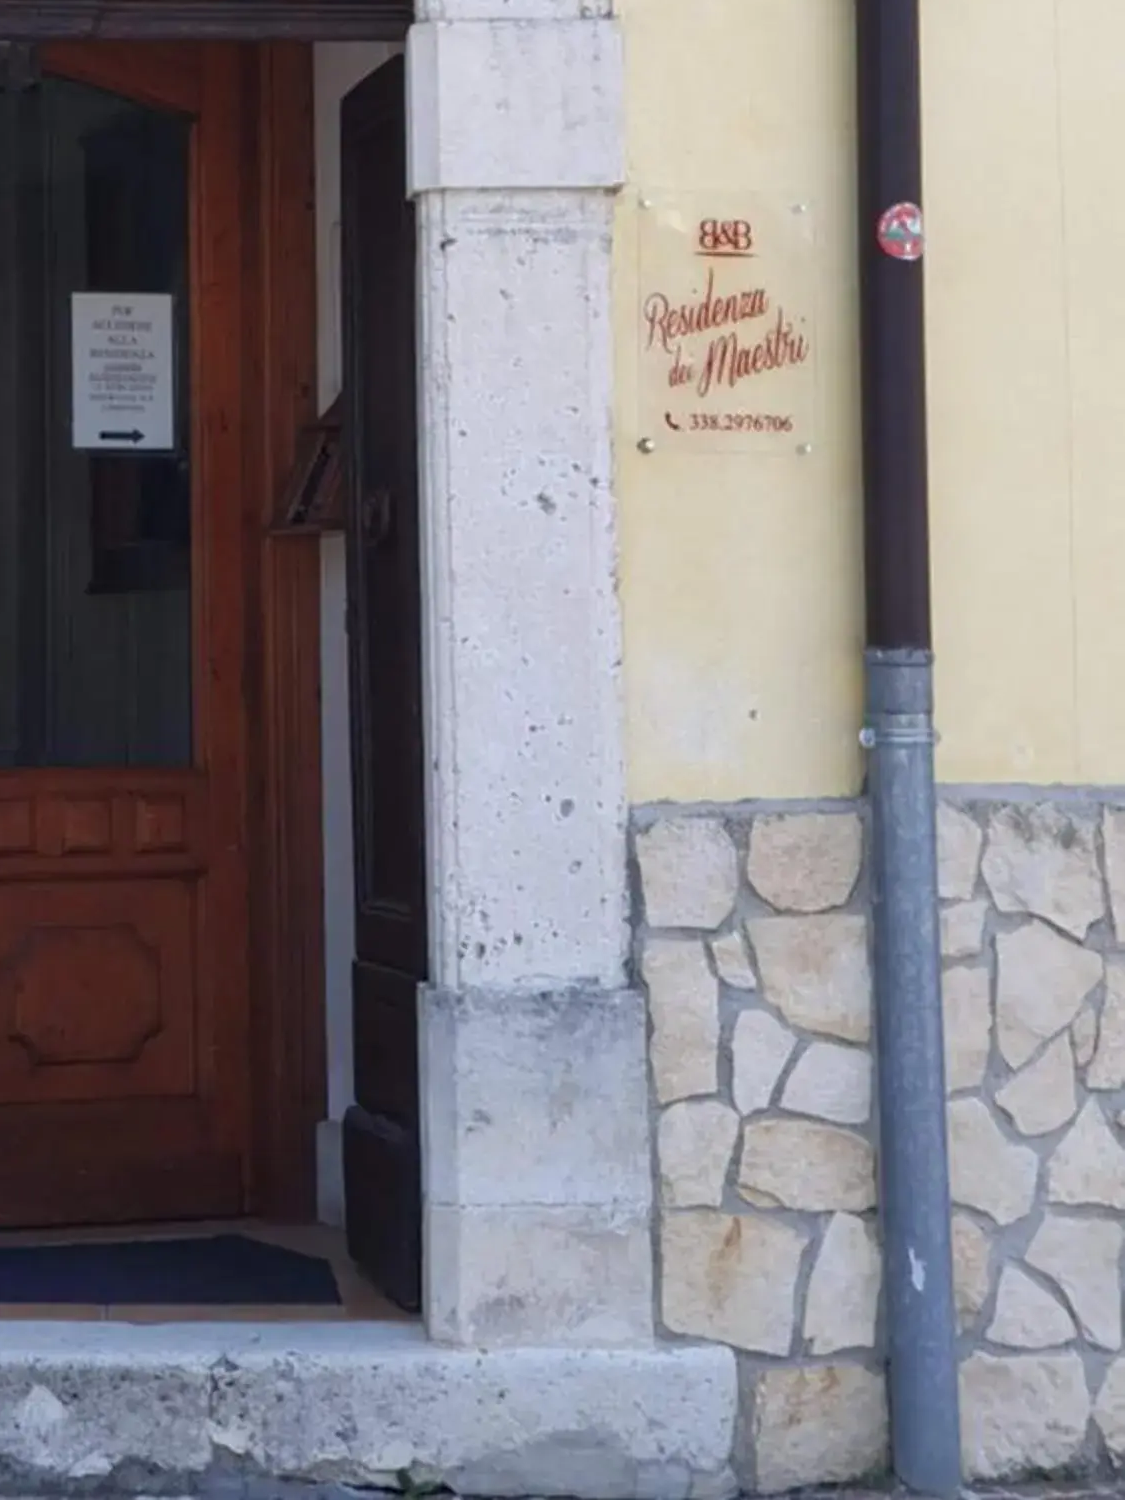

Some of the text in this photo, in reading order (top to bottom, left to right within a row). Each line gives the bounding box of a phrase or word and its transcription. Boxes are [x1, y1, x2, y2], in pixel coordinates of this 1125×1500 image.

[699, 218, 752, 250] B&B
[643, 267, 769, 354] Residenza
[697, 305, 809, 398] Maestri
